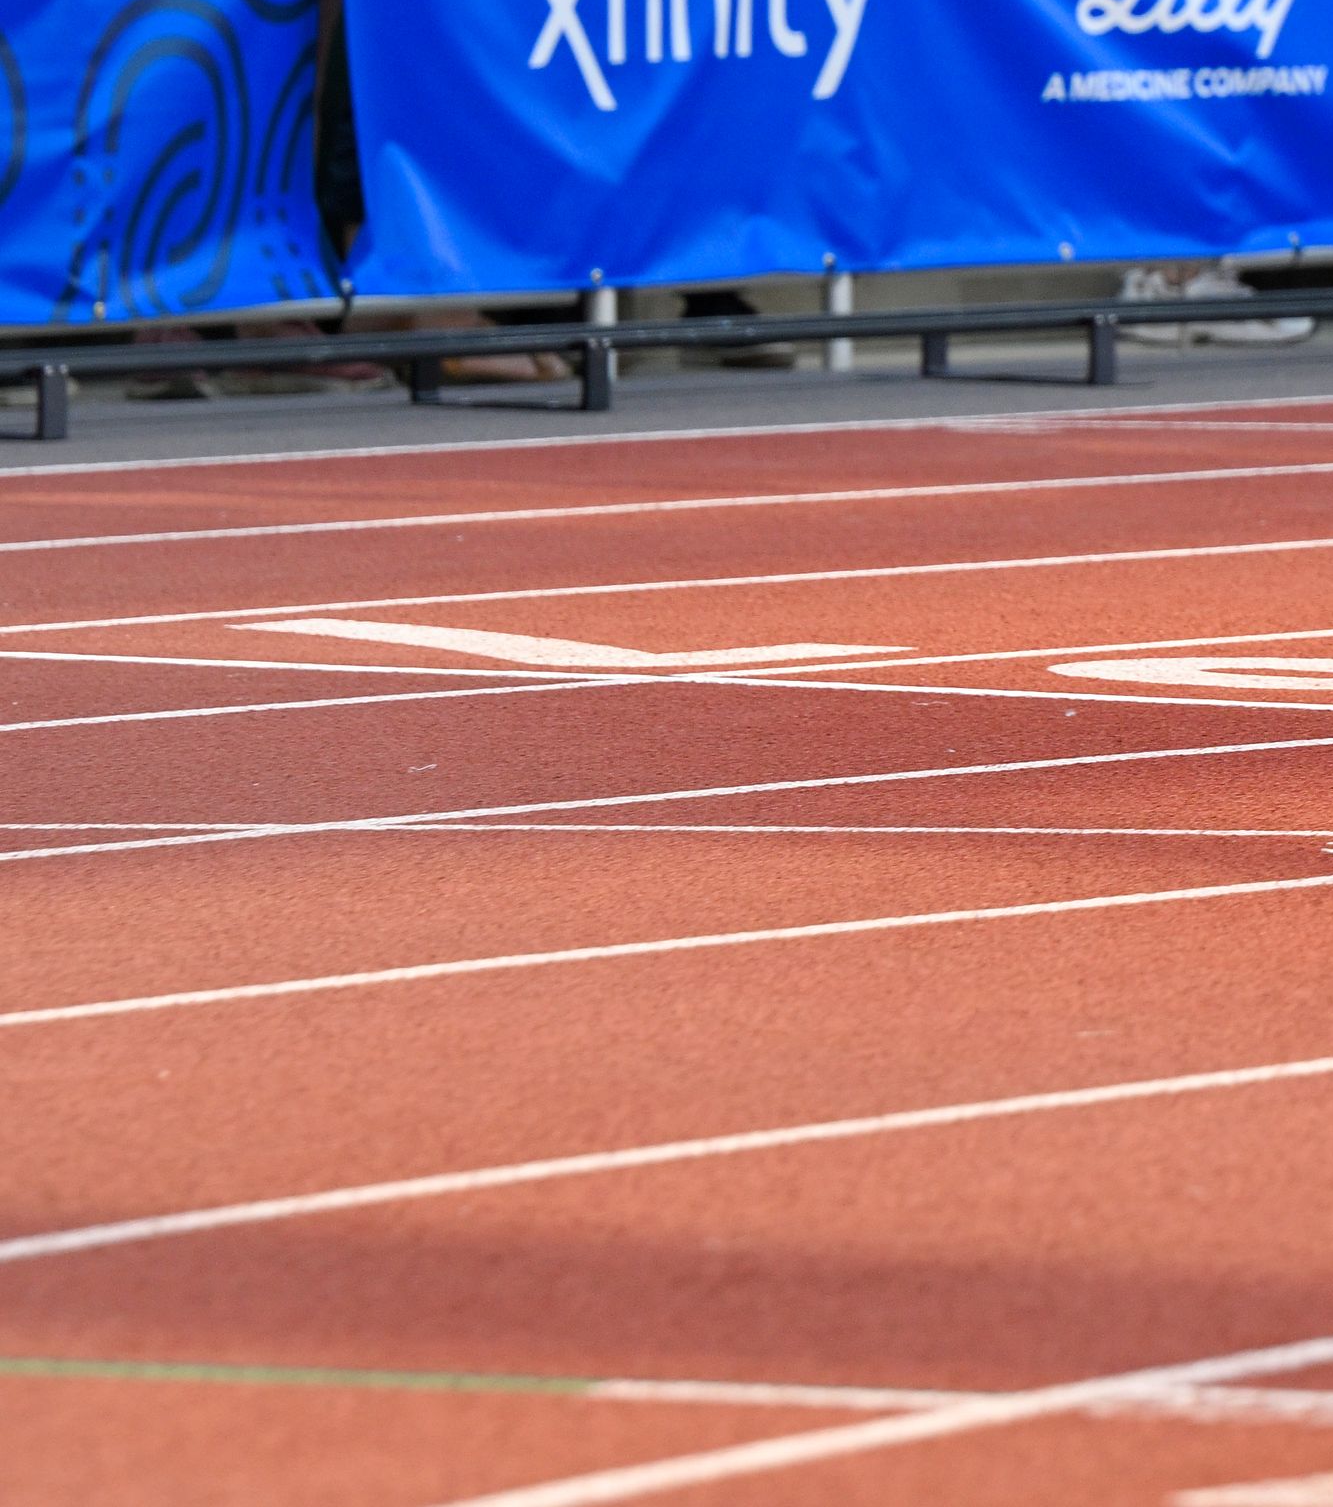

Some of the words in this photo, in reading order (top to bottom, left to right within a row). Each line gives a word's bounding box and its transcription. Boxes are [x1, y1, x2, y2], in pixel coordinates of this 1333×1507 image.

[1041, 70, 1067, 103] A
[1069, 67, 1193, 103] MEDICINE
[1194, 64, 1329, 100] COMPANY
